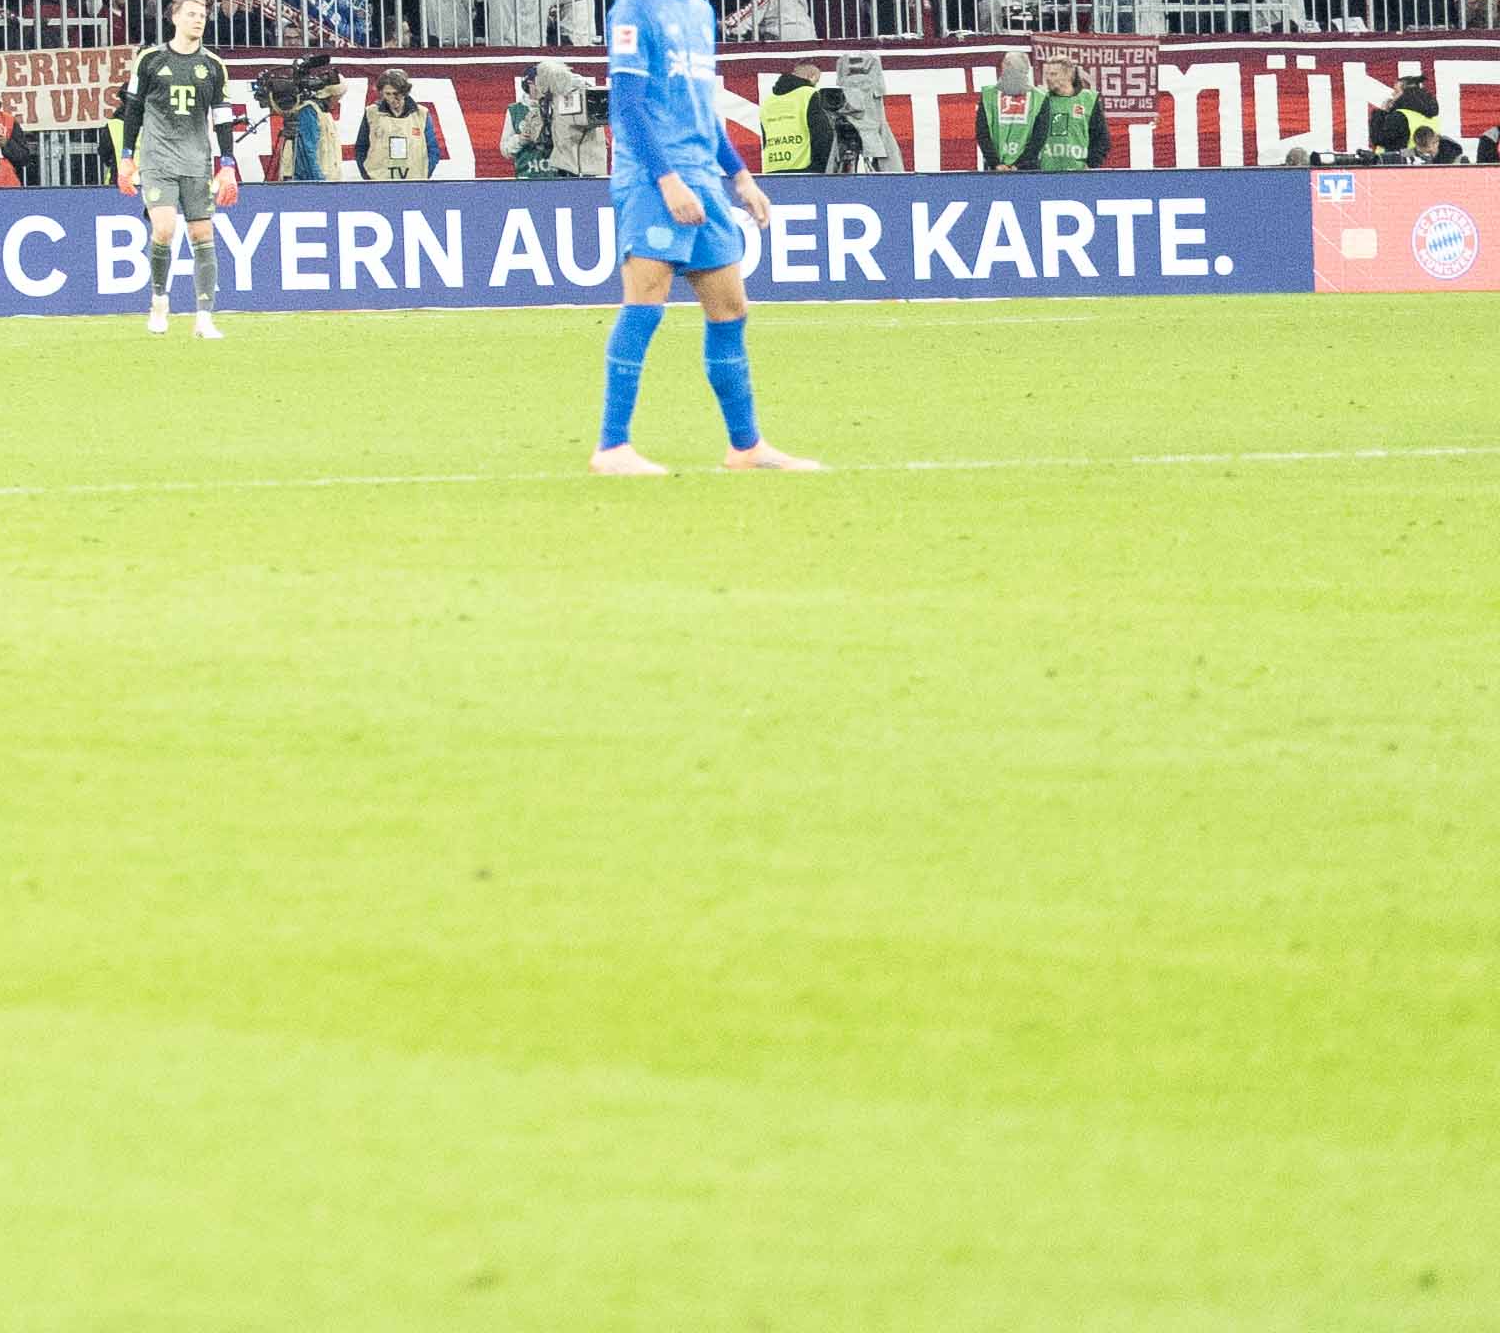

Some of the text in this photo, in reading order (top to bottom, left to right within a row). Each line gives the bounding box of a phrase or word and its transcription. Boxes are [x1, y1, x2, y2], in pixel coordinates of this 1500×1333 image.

[169, 85, 196, 115] T
[489, 204, 617, 289] AU
[913, 196, 1235, 282] KARTE.
